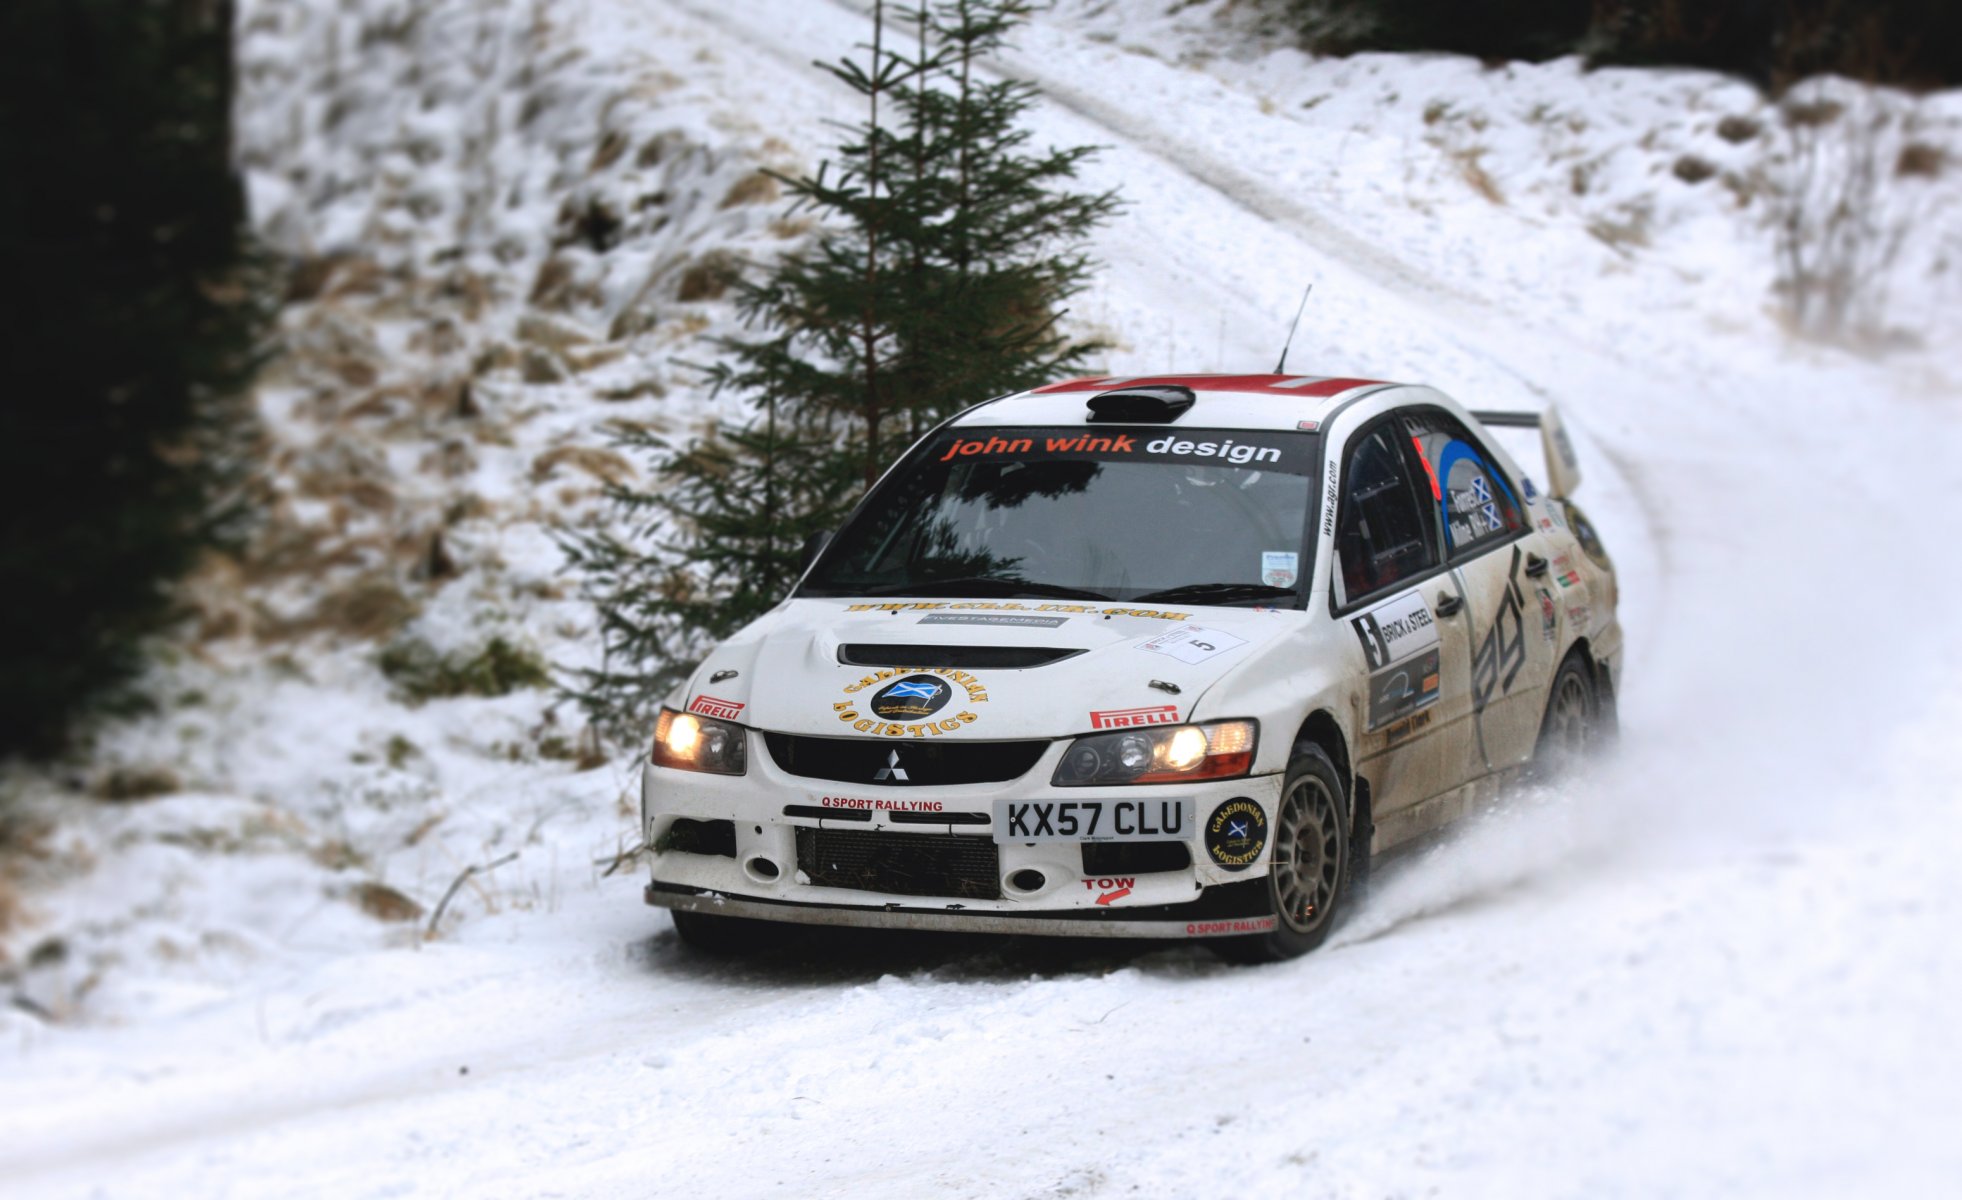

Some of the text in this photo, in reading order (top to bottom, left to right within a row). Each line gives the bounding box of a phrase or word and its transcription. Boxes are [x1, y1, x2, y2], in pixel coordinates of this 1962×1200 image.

[941, 434, 1281, 463] john wink design
[1323, 460, 1338, 536] www.agr.com
[1381, 618, 1408, 643] BRICK
[1408, 608, 1433, 631] STEEL
[1189, 640, 1216, 651] 5
[1359, 618, 1382, 667] 5
[689, 694, 745, 720] PIRELLI
[833, 700, 977, 737] LOGISTICS
[1089, 705, 1180, 729] PIRELLI
[822, 797, 943, 811] Q SPORT RALLYING
[1212, 802, 1264, 833] CALEDONIAN
[1008, 801, 1182, 836] KX57 CLU
[1212, 840, 1263, 865] LOGISTICS
[1081, 877, 1135, 890] TOW
[1186, 917, 1277, 935] Q SPORT RALLYIN
